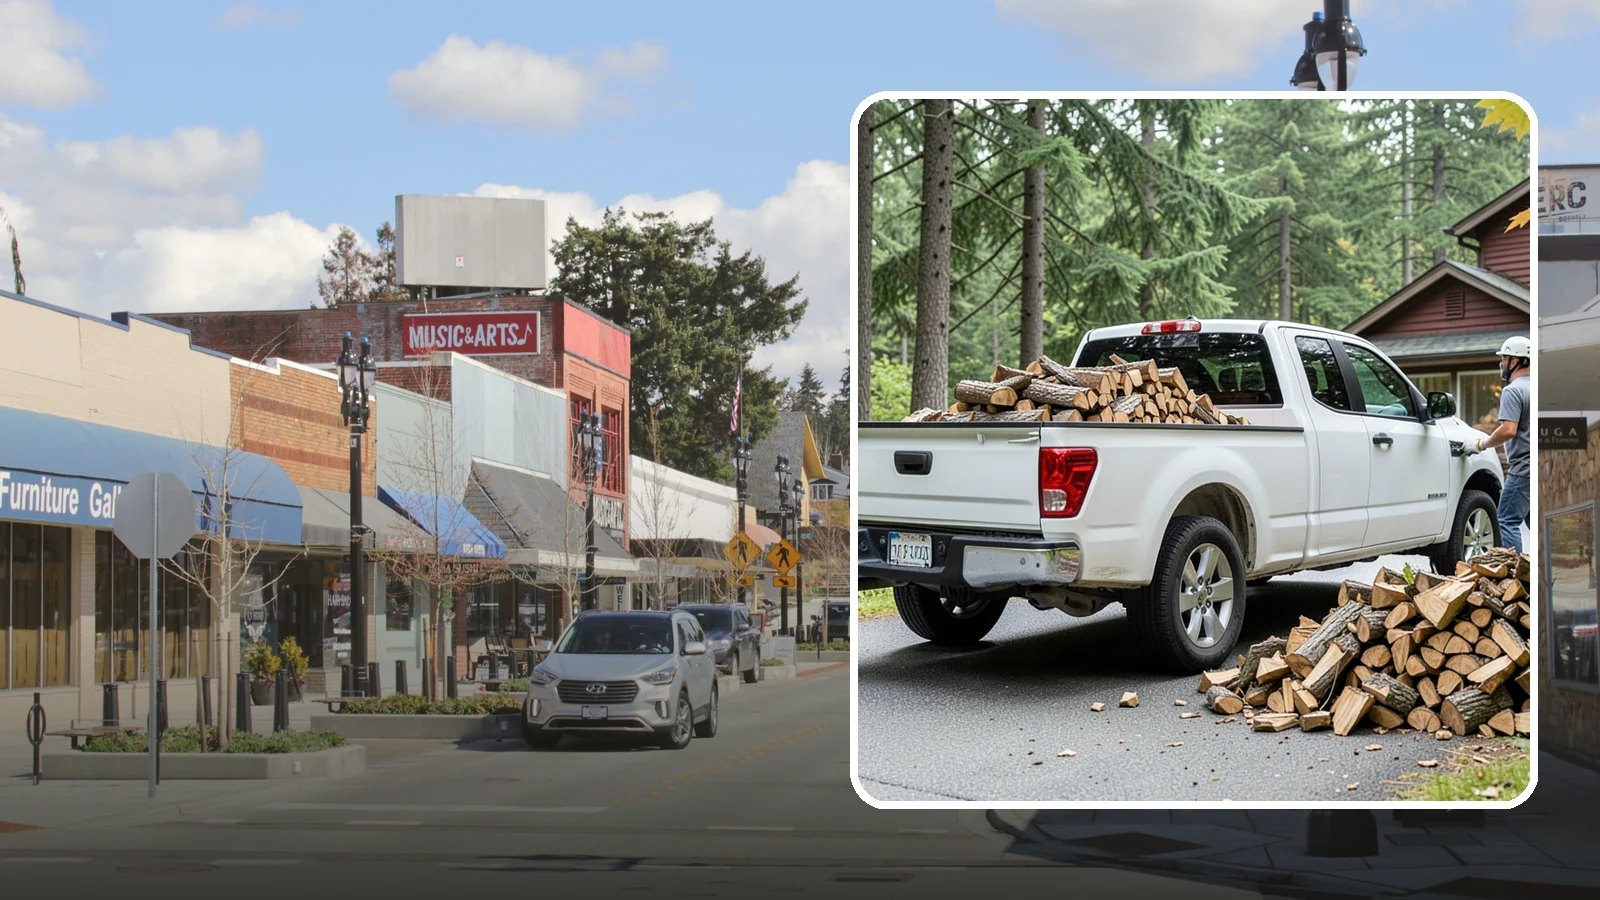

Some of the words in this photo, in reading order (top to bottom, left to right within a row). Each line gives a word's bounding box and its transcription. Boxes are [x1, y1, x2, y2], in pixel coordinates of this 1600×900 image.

[1540, 427, 1578, 437] UGA
[0, 471, 79, 515] Furniture
[89, 482, 122, 519] Gal
